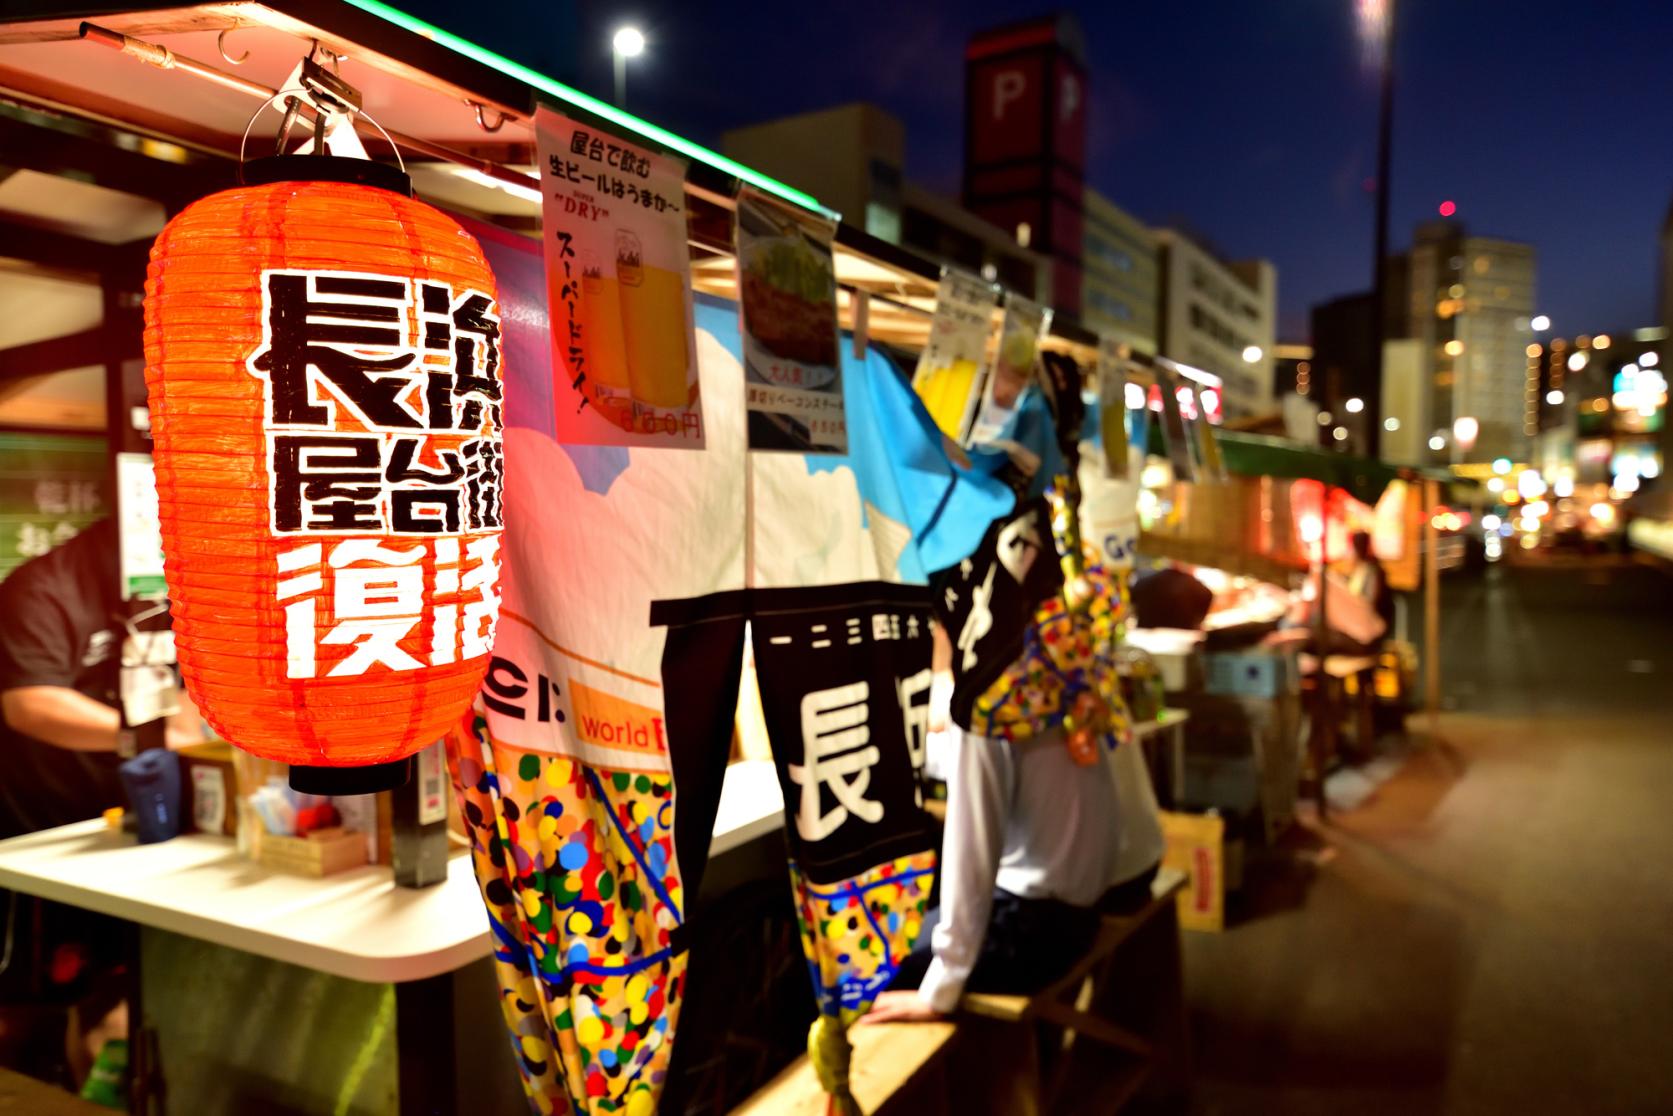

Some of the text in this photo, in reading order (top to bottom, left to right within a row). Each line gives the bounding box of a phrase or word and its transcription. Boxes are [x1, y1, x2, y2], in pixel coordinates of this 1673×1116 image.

[994, 70, 1025, 120] P
[570, 131, 651, 178] 屋台で飲む
